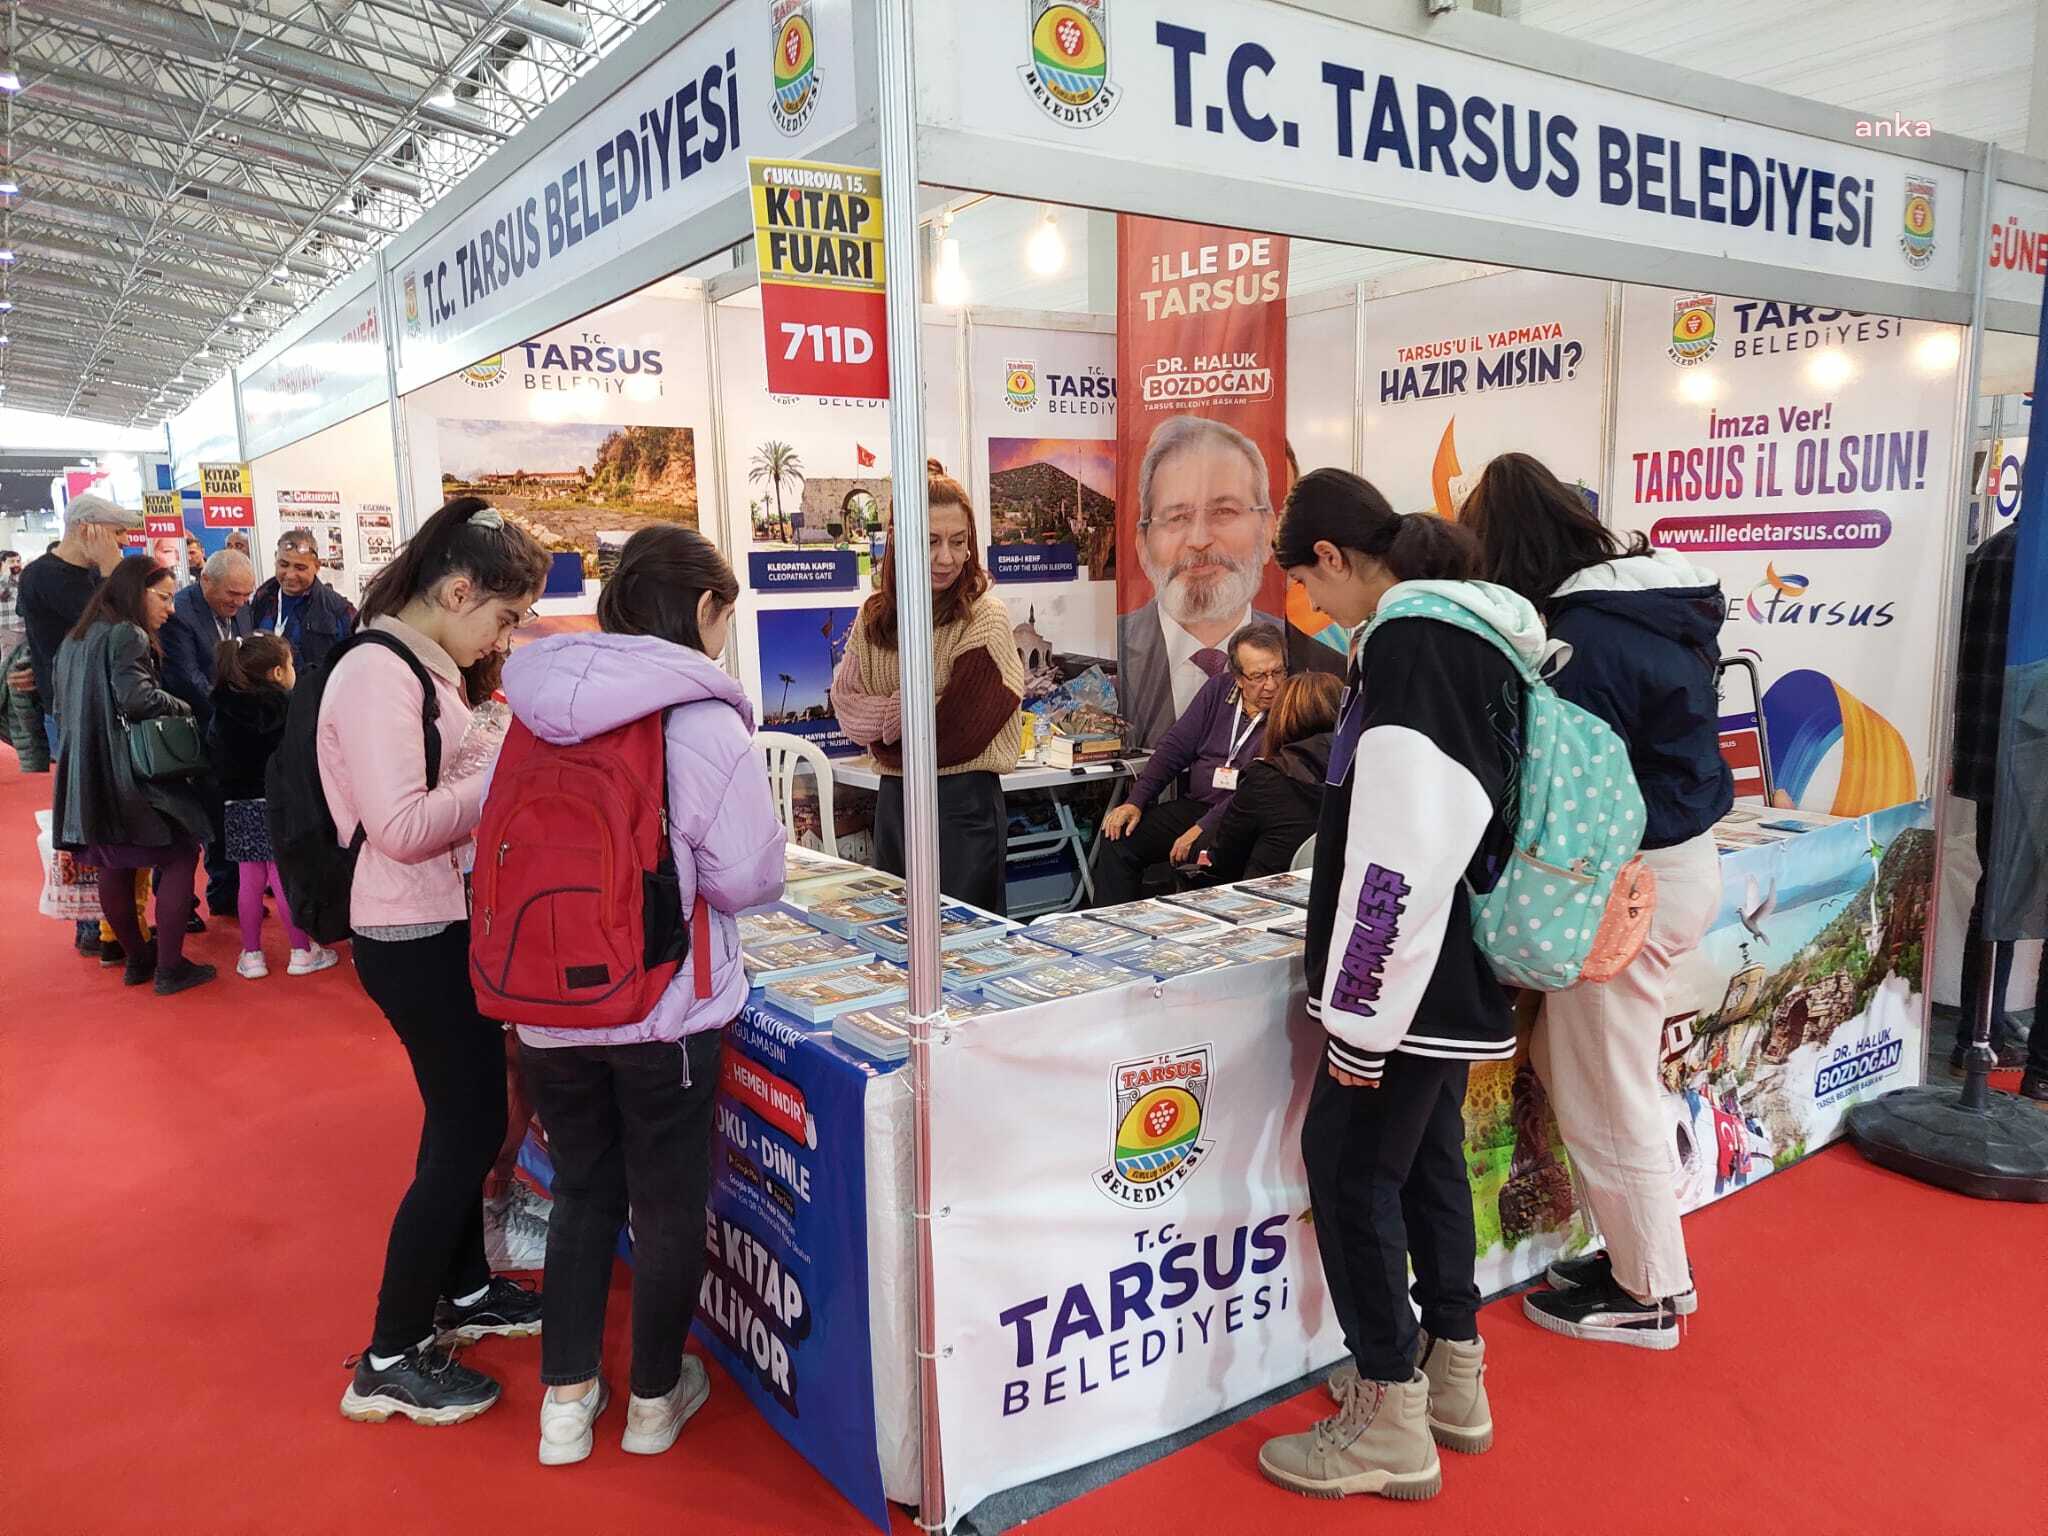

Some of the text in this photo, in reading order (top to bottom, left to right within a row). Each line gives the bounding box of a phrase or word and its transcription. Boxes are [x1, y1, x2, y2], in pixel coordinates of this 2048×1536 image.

[1156, 20, 1874, 248] T.C. TARSUS BELEDİYESİ
[423, 48, 741, 327] T.C. TARSUS BELEDİYESİ
[846, 174, 867, 194] 15.
[770, 232, 873, 280] FUARI
[1151, 238, 1270, 283] İLLE DE
[1140, 270, 1280, 322] TARSUS
[581, 333, 606, 344] T.C.
[780, 322, 874, 364] 711D
[1488, 323, 1563, 348] YAPMAYA
[1734, 318, 1902, 358] BELEDİYESİ
[520, 342, 663, 375] TARSUS
[1088, 366, 1105, 376] T.C.
[1156, 352, 1257, 373] DR. HALUK
[1380, 341, 1583, 403] HAZIR MISIN?
[1149, 370, 1266, 398] BOZDOĞAN
[1144, 401, 1175, 411] TARSUS
[1709, 402, 1833, 439] İmza Ver!
[1633, 430, 1929, 503] TARSUS İL OLSUN!
[206, 482, 242, 493] FUARI
[150, 522, 176, 532] 711B
[209, 505, 244, 519] 711C
[1658, 521, 1881, 545] www.illedetarsus.com
[767, 561, 836, 571] KLEOPATRA KAPISI
[815, 572, 833, 580] GATE
[998, 565, 1012, 573] CAVE
[1013, 564, 1020, 572] OF
[1021, 564, 1031, 572] THE
[1032, 563, 1048, 571] SEVEN
[1833, 1027, 1892, 1062] DR. HALUK
[733, 1062, 768, 1102] HEMEN
[1121, 1059, 1204, 1089] TARSUS
[761, 1135, 811, 1204] DİNLE
[1134, 1222, 1182, 1254] T.C.
[722, 1220, 803, 1329] KİTAP
[999, 1213, 1290, 1368] TARSUS
[699, 1269, 791, 1397] KLİYOR
[1002, 1277, 1289, 1418] BELEDİYESİ
